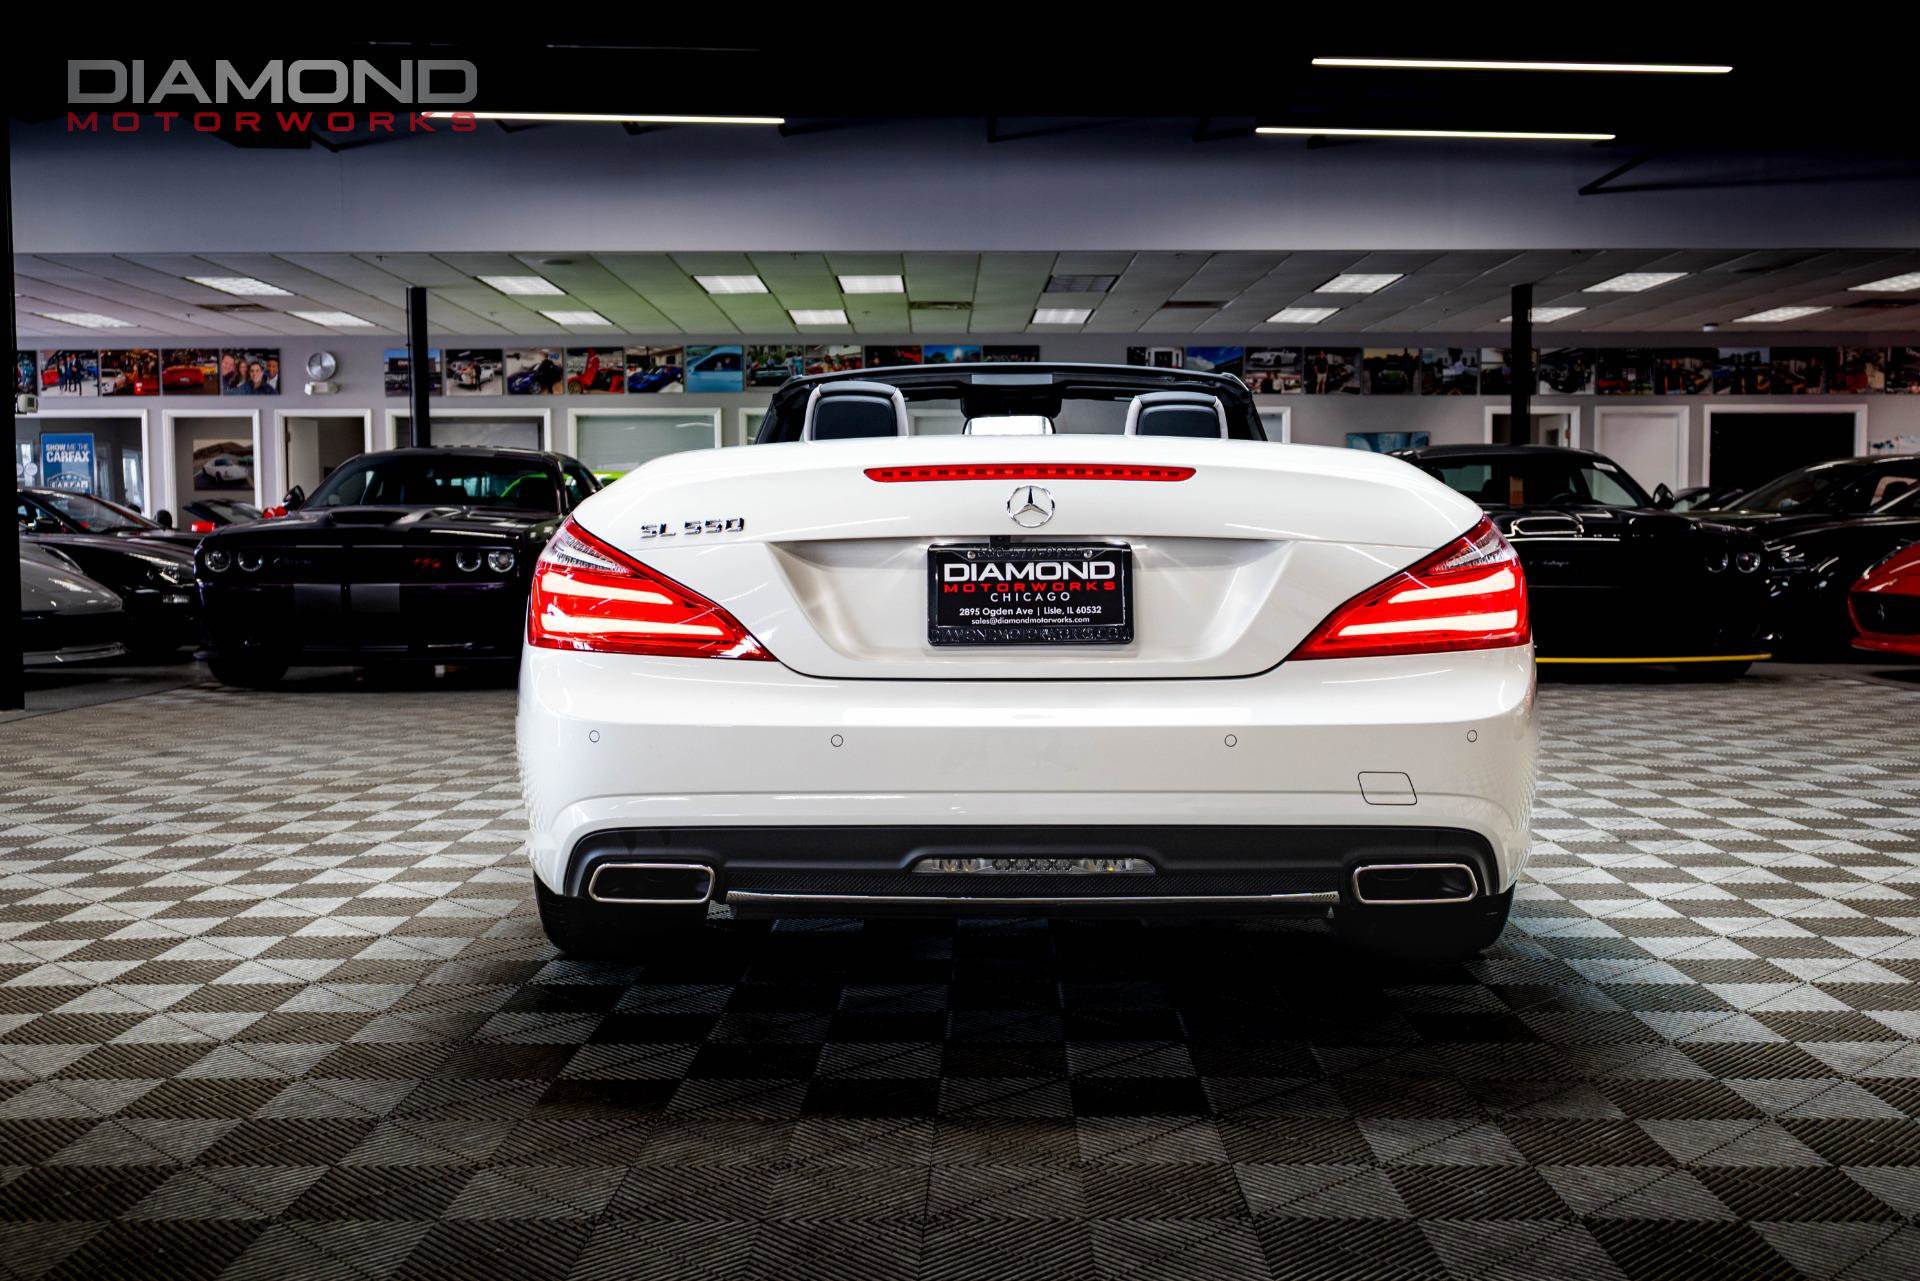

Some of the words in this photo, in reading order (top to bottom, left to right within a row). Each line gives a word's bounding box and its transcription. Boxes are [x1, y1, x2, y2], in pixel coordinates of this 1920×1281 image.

[45, 443, 65, 451] SHOW
[66, 443, 77, 451] ME
[46, 451, 90, 463] CARFAX
[640, 522, 677, 539] SL
[684, 517, 745, 536] 550
[943, 561, 1116, 582] DIAMOND
[943, 581, 1116, 593] MOTORWORKS
[990, 592, 1070, 602] CHICAGO
[959, 607, 980, 616] 2895
[982, 607, 1014, 617] Ogden
[1016, 606, 1034, 615] Ave
[1043, 605, 1065, 616] Lisle,
[1066, 606, 1075, 615] IL
[1076, 605, 1102, 615] 60532
[971, 616, 1090, 626] sales@diamondmotorworks.com
